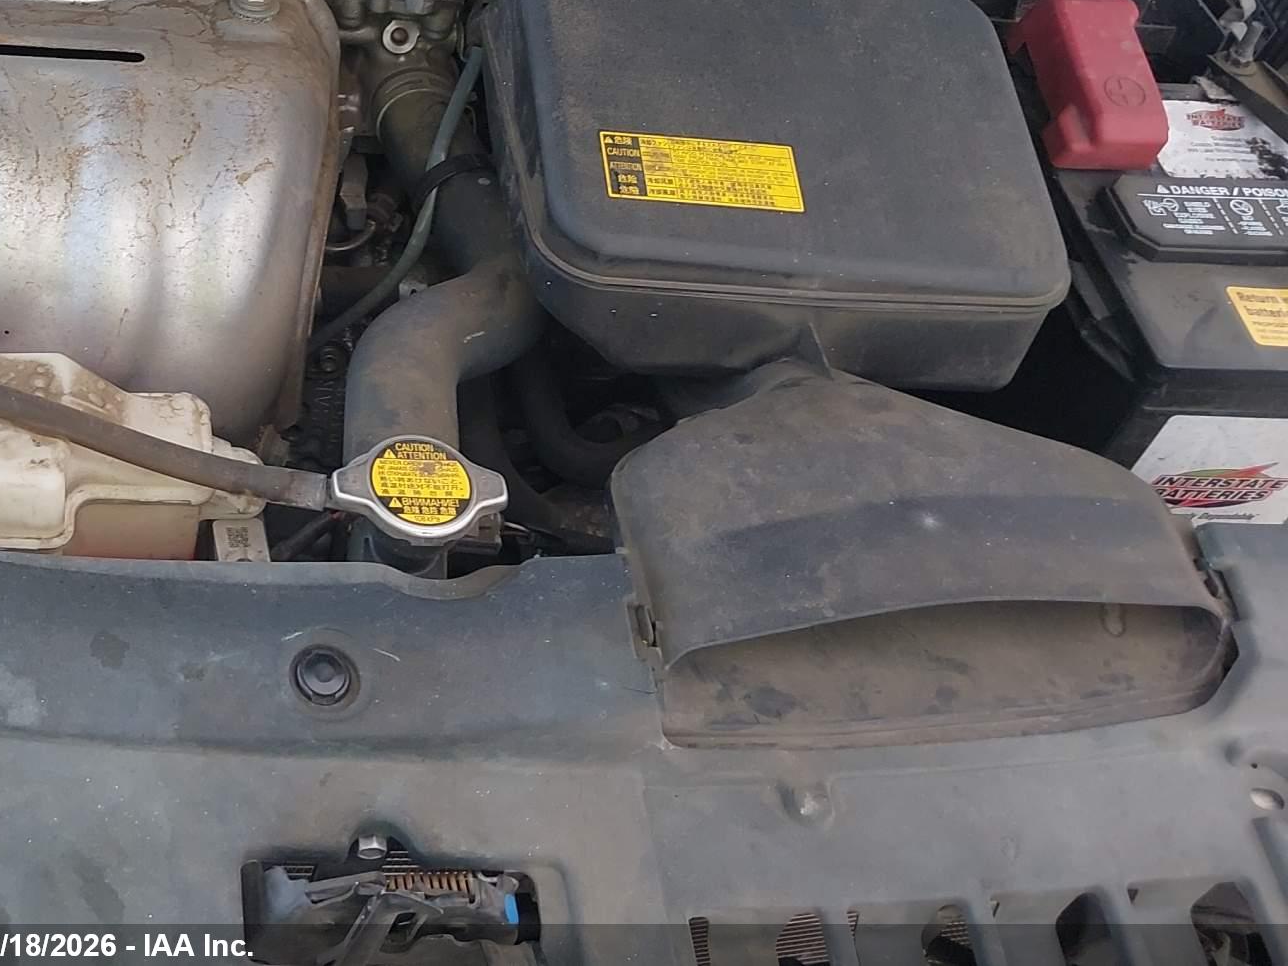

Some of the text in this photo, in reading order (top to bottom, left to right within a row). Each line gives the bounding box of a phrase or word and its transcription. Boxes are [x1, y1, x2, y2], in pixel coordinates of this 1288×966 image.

[607, 147, 640, 157] CAUTION
[1169, 185, 1231, 196] DANGER
[395, 442, 434, 452] CAUTION
[397, 451, 447, 460] ATTENTION
[1154, 476, 1284, 489] INTERSTATE
[402, 497, 460, 508] ВНИМАНИЕ!
